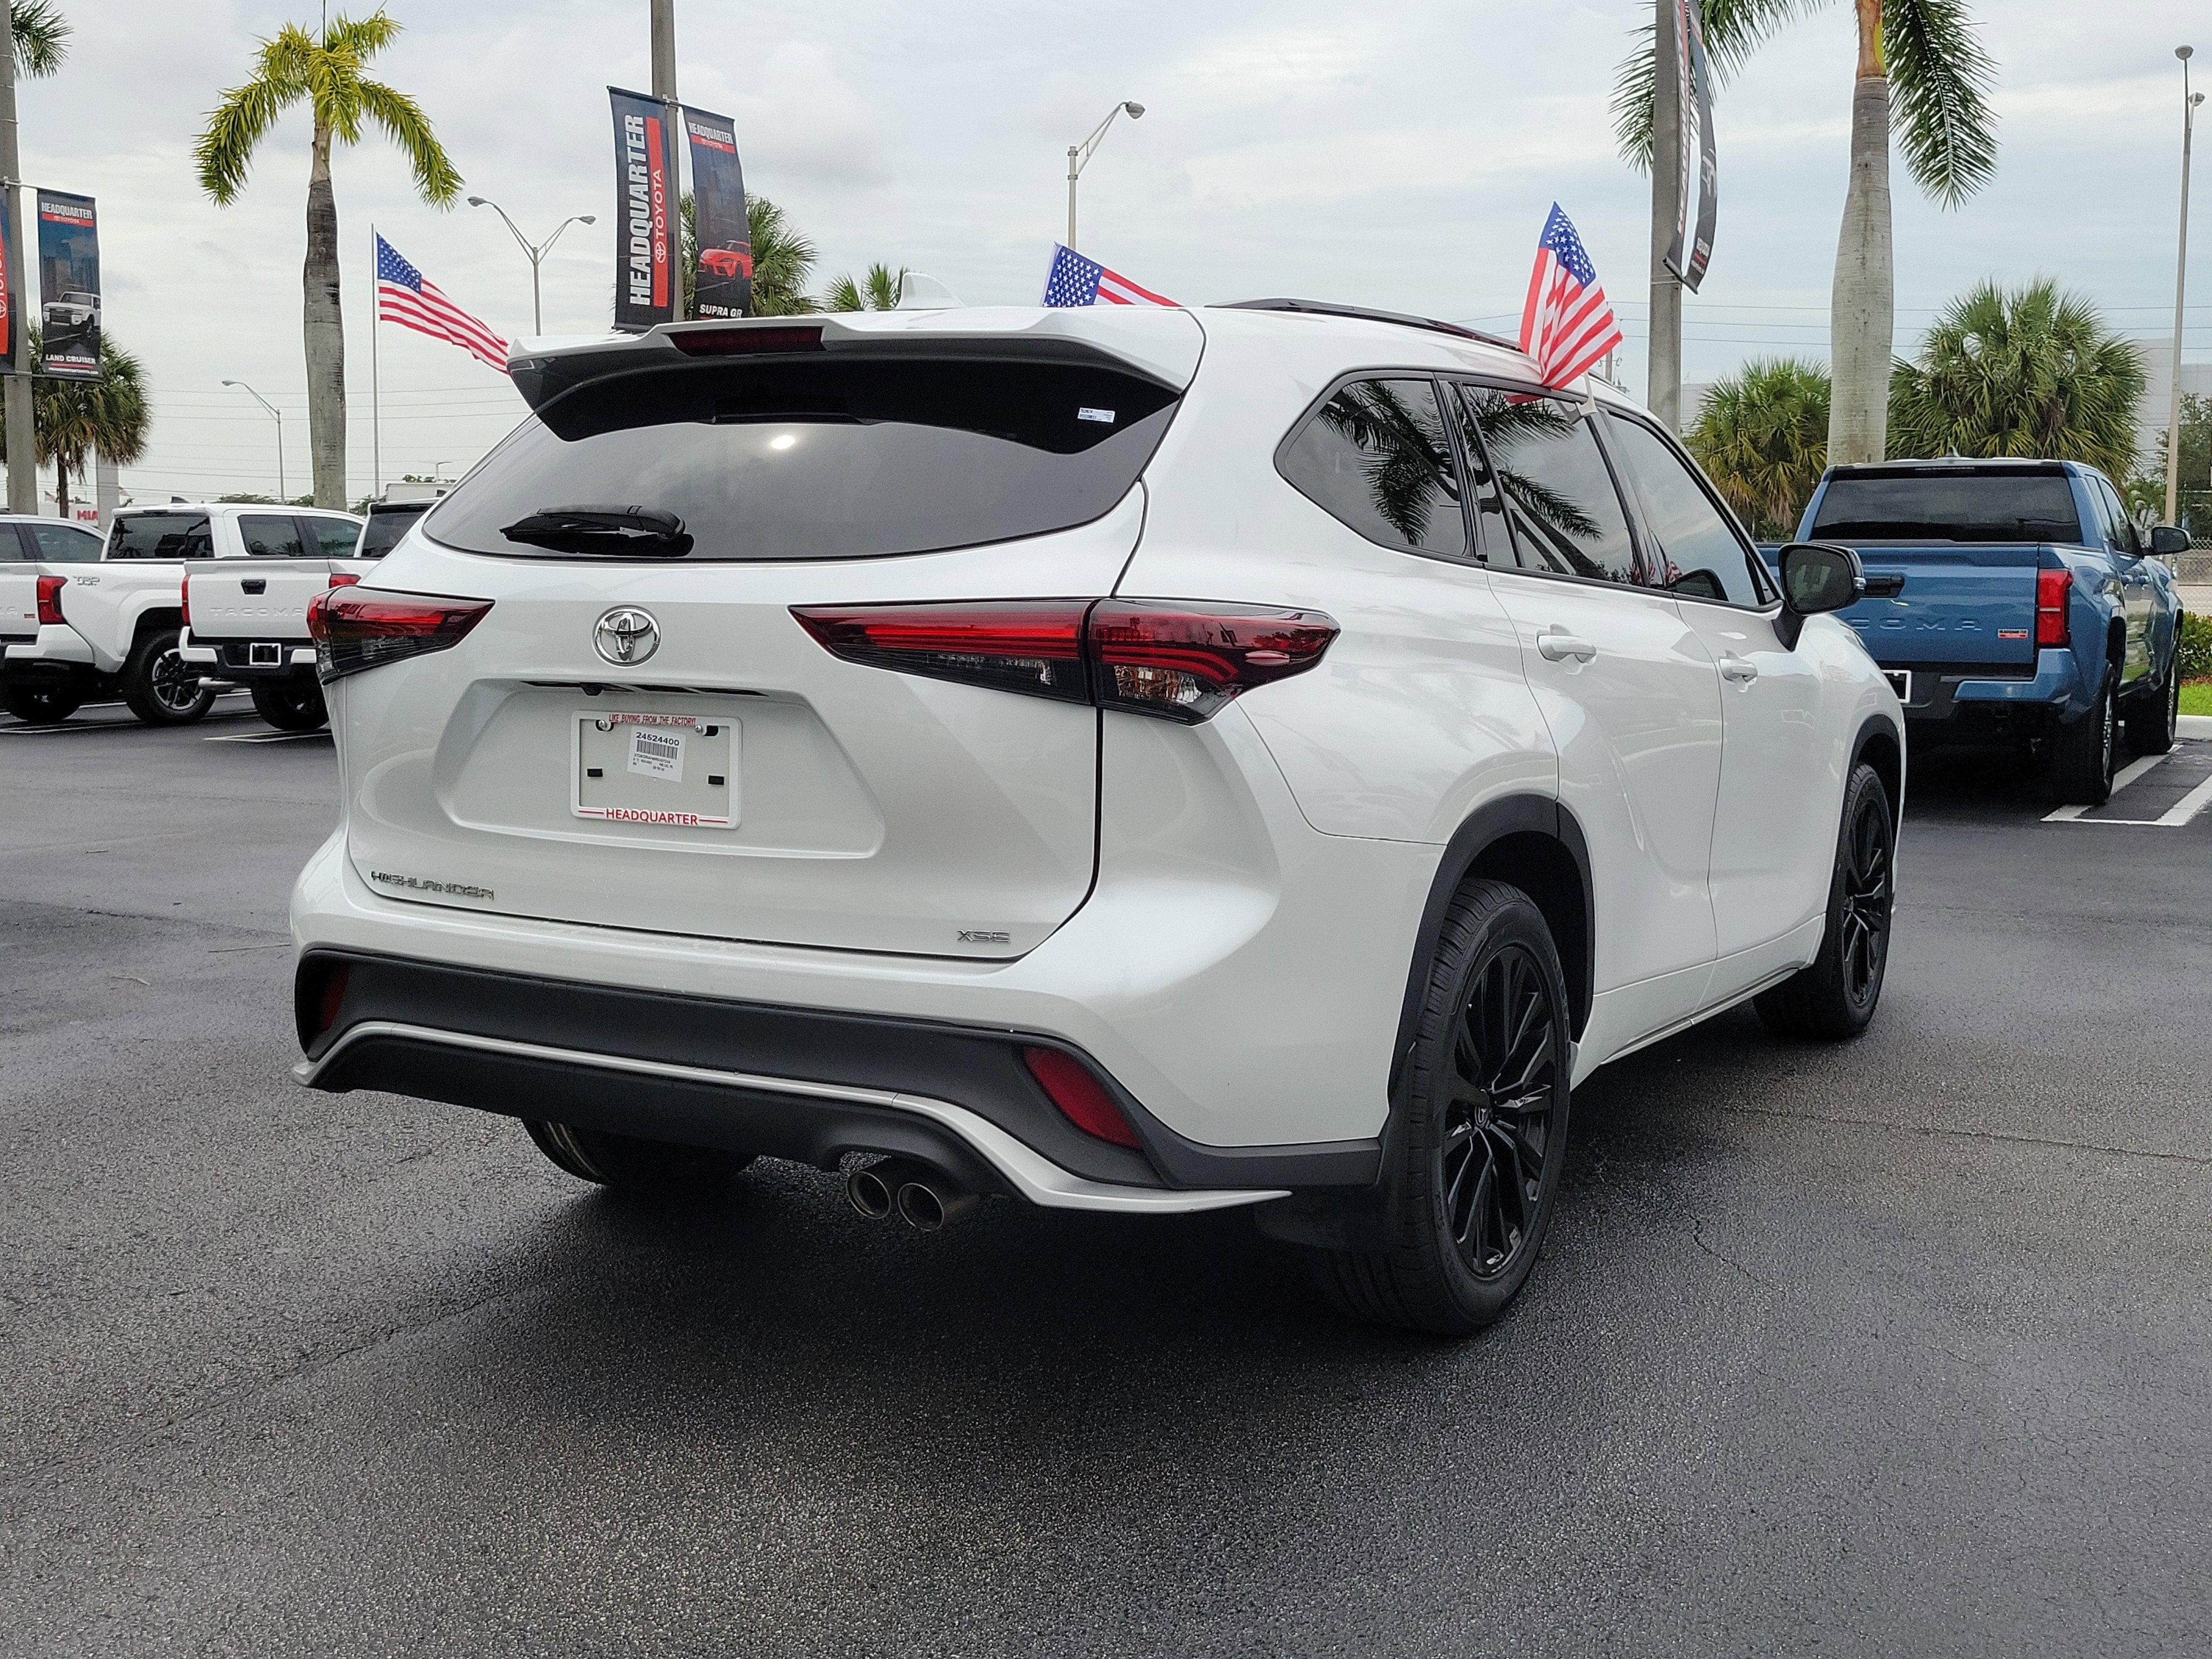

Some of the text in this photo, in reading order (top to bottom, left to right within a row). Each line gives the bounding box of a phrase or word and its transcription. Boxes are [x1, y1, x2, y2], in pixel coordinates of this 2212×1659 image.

[688, 122, 734, 144] HEADQUARTER
[41, 202, 93, 219] HEADQUARTER
[625, 115, 653, 305] HEADQUARTER
[653, 169, 665, 239] TOYOTA
[699, 304, 743, 319] SUPRA GR
[66, 355, 97, 364] CRUISER
[209, 607, 306, 617] TACOMA
[609, 713, 619, 722] LIKE
[621, 714, 640, 723] BUYING
[642, 715, 657, 724] FROM
[659, 716, 669, 725] THE
[606, 808, 699, 826] HEADQUARTER
[956, 929, 1011, 943] XSE
